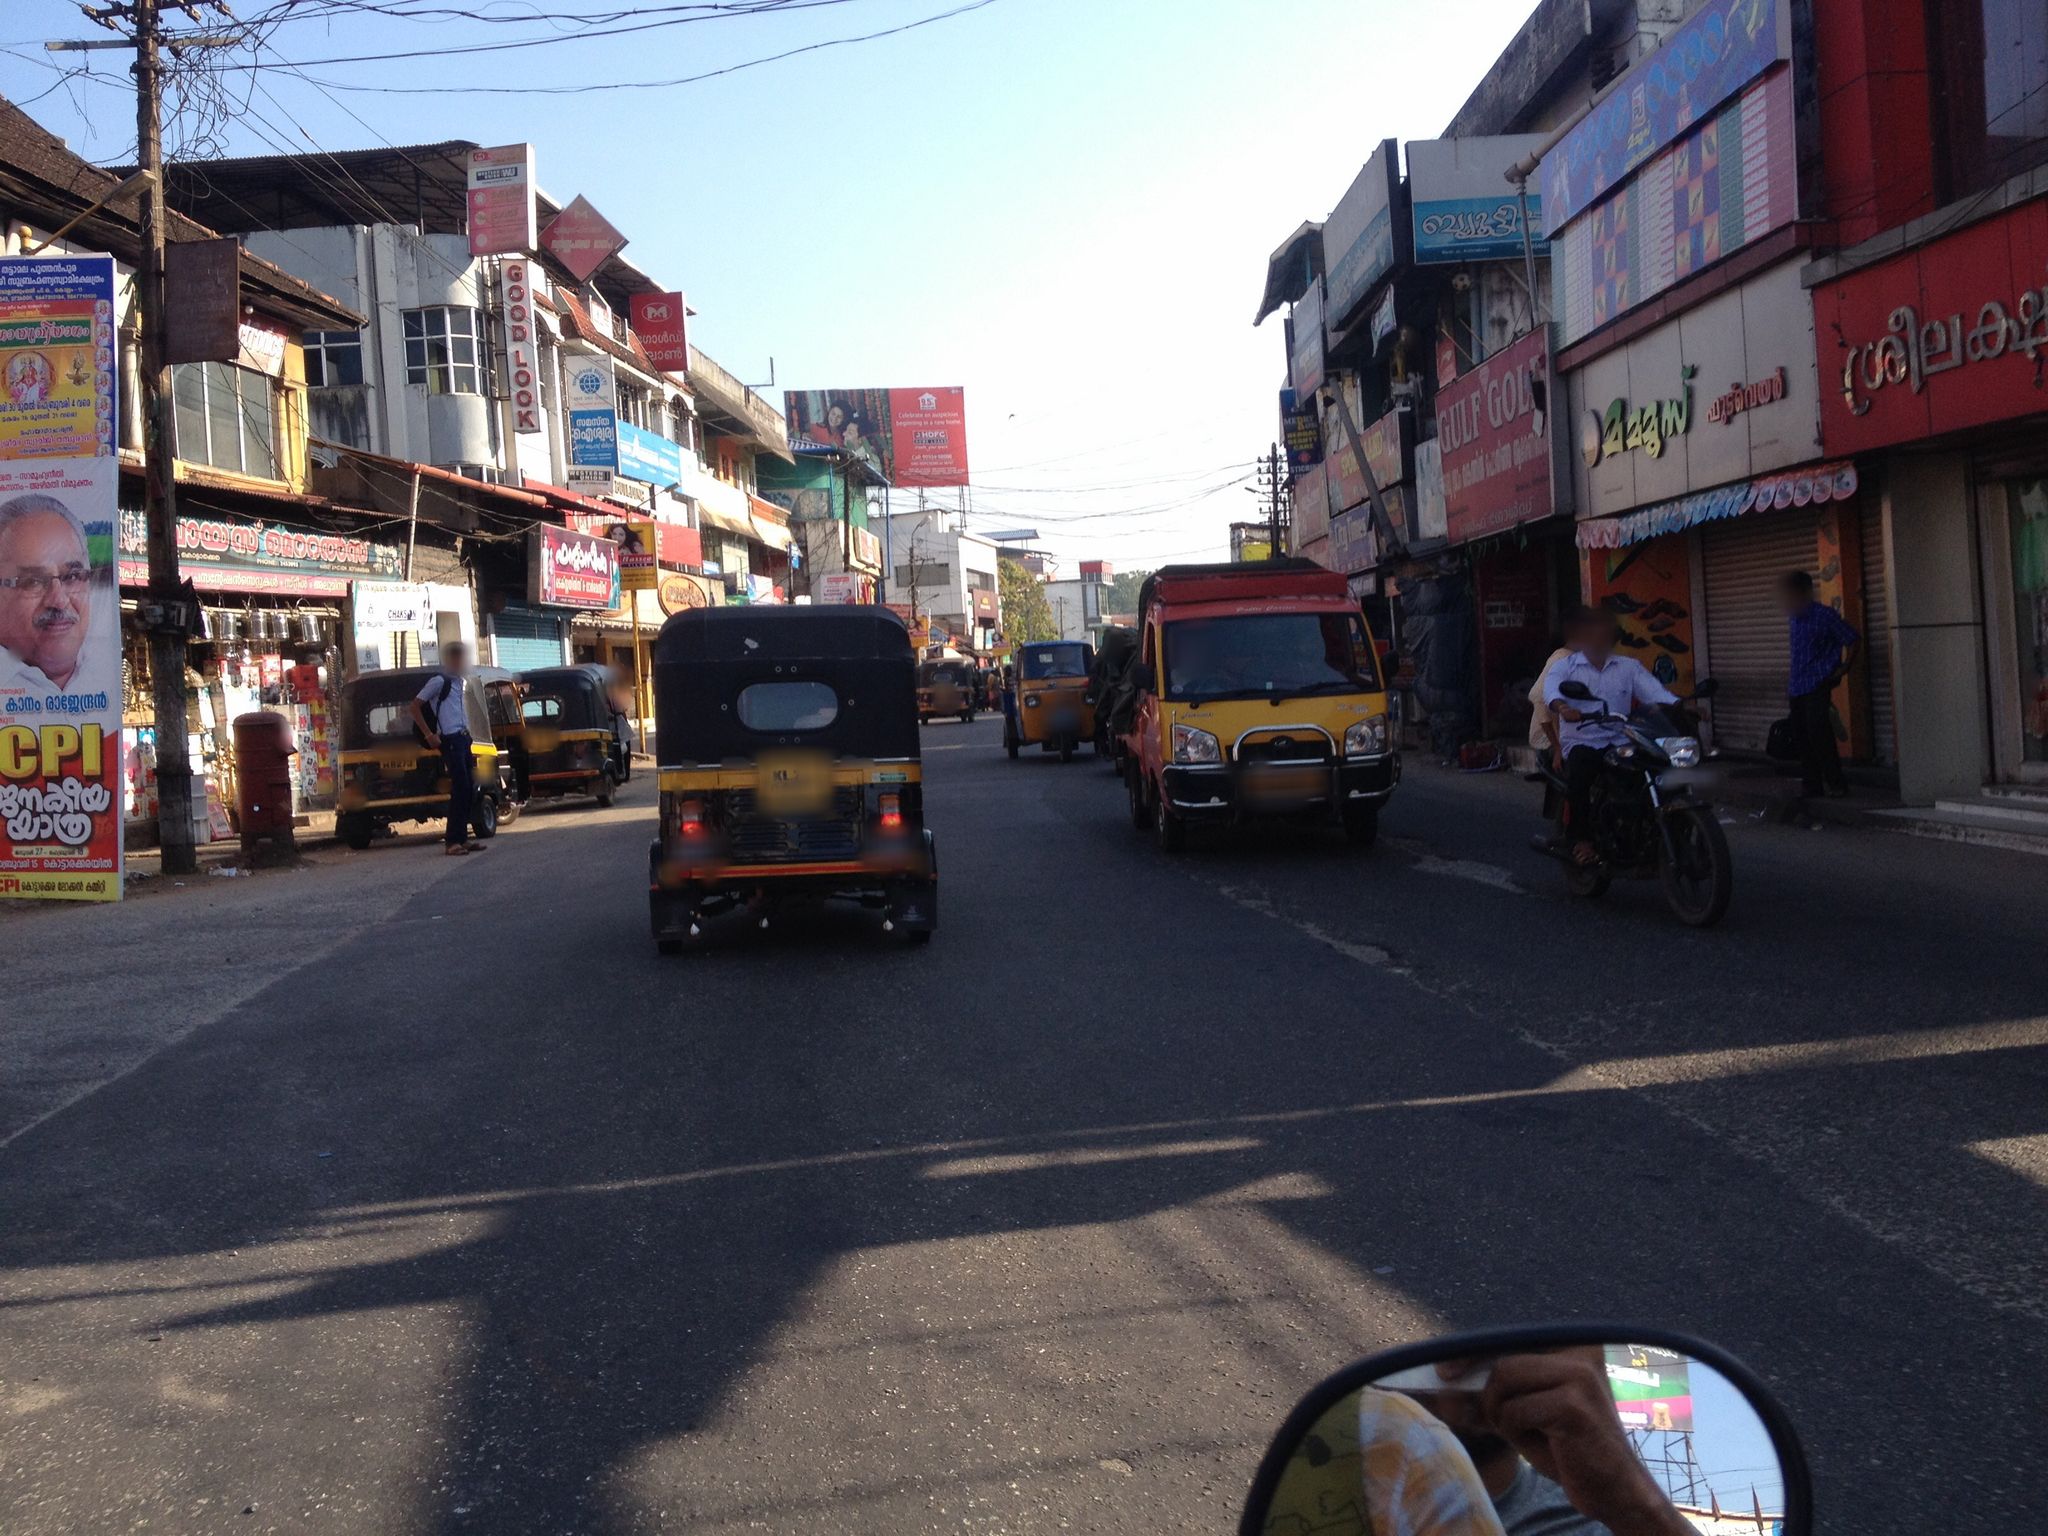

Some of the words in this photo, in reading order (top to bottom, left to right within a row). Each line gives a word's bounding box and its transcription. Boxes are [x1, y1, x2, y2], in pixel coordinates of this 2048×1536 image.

[507, 264, 528, 342] GOOD
[514, 350, 536, 428] LOOK
[1438, 390, 1481, 454] GULF
[1487, 354, 1547, 430] GOL
[6, 696, 41, 713] കാനം
[0, 723, 101, 779] CPI
[6, 811, 92, 846] യാത്ര
